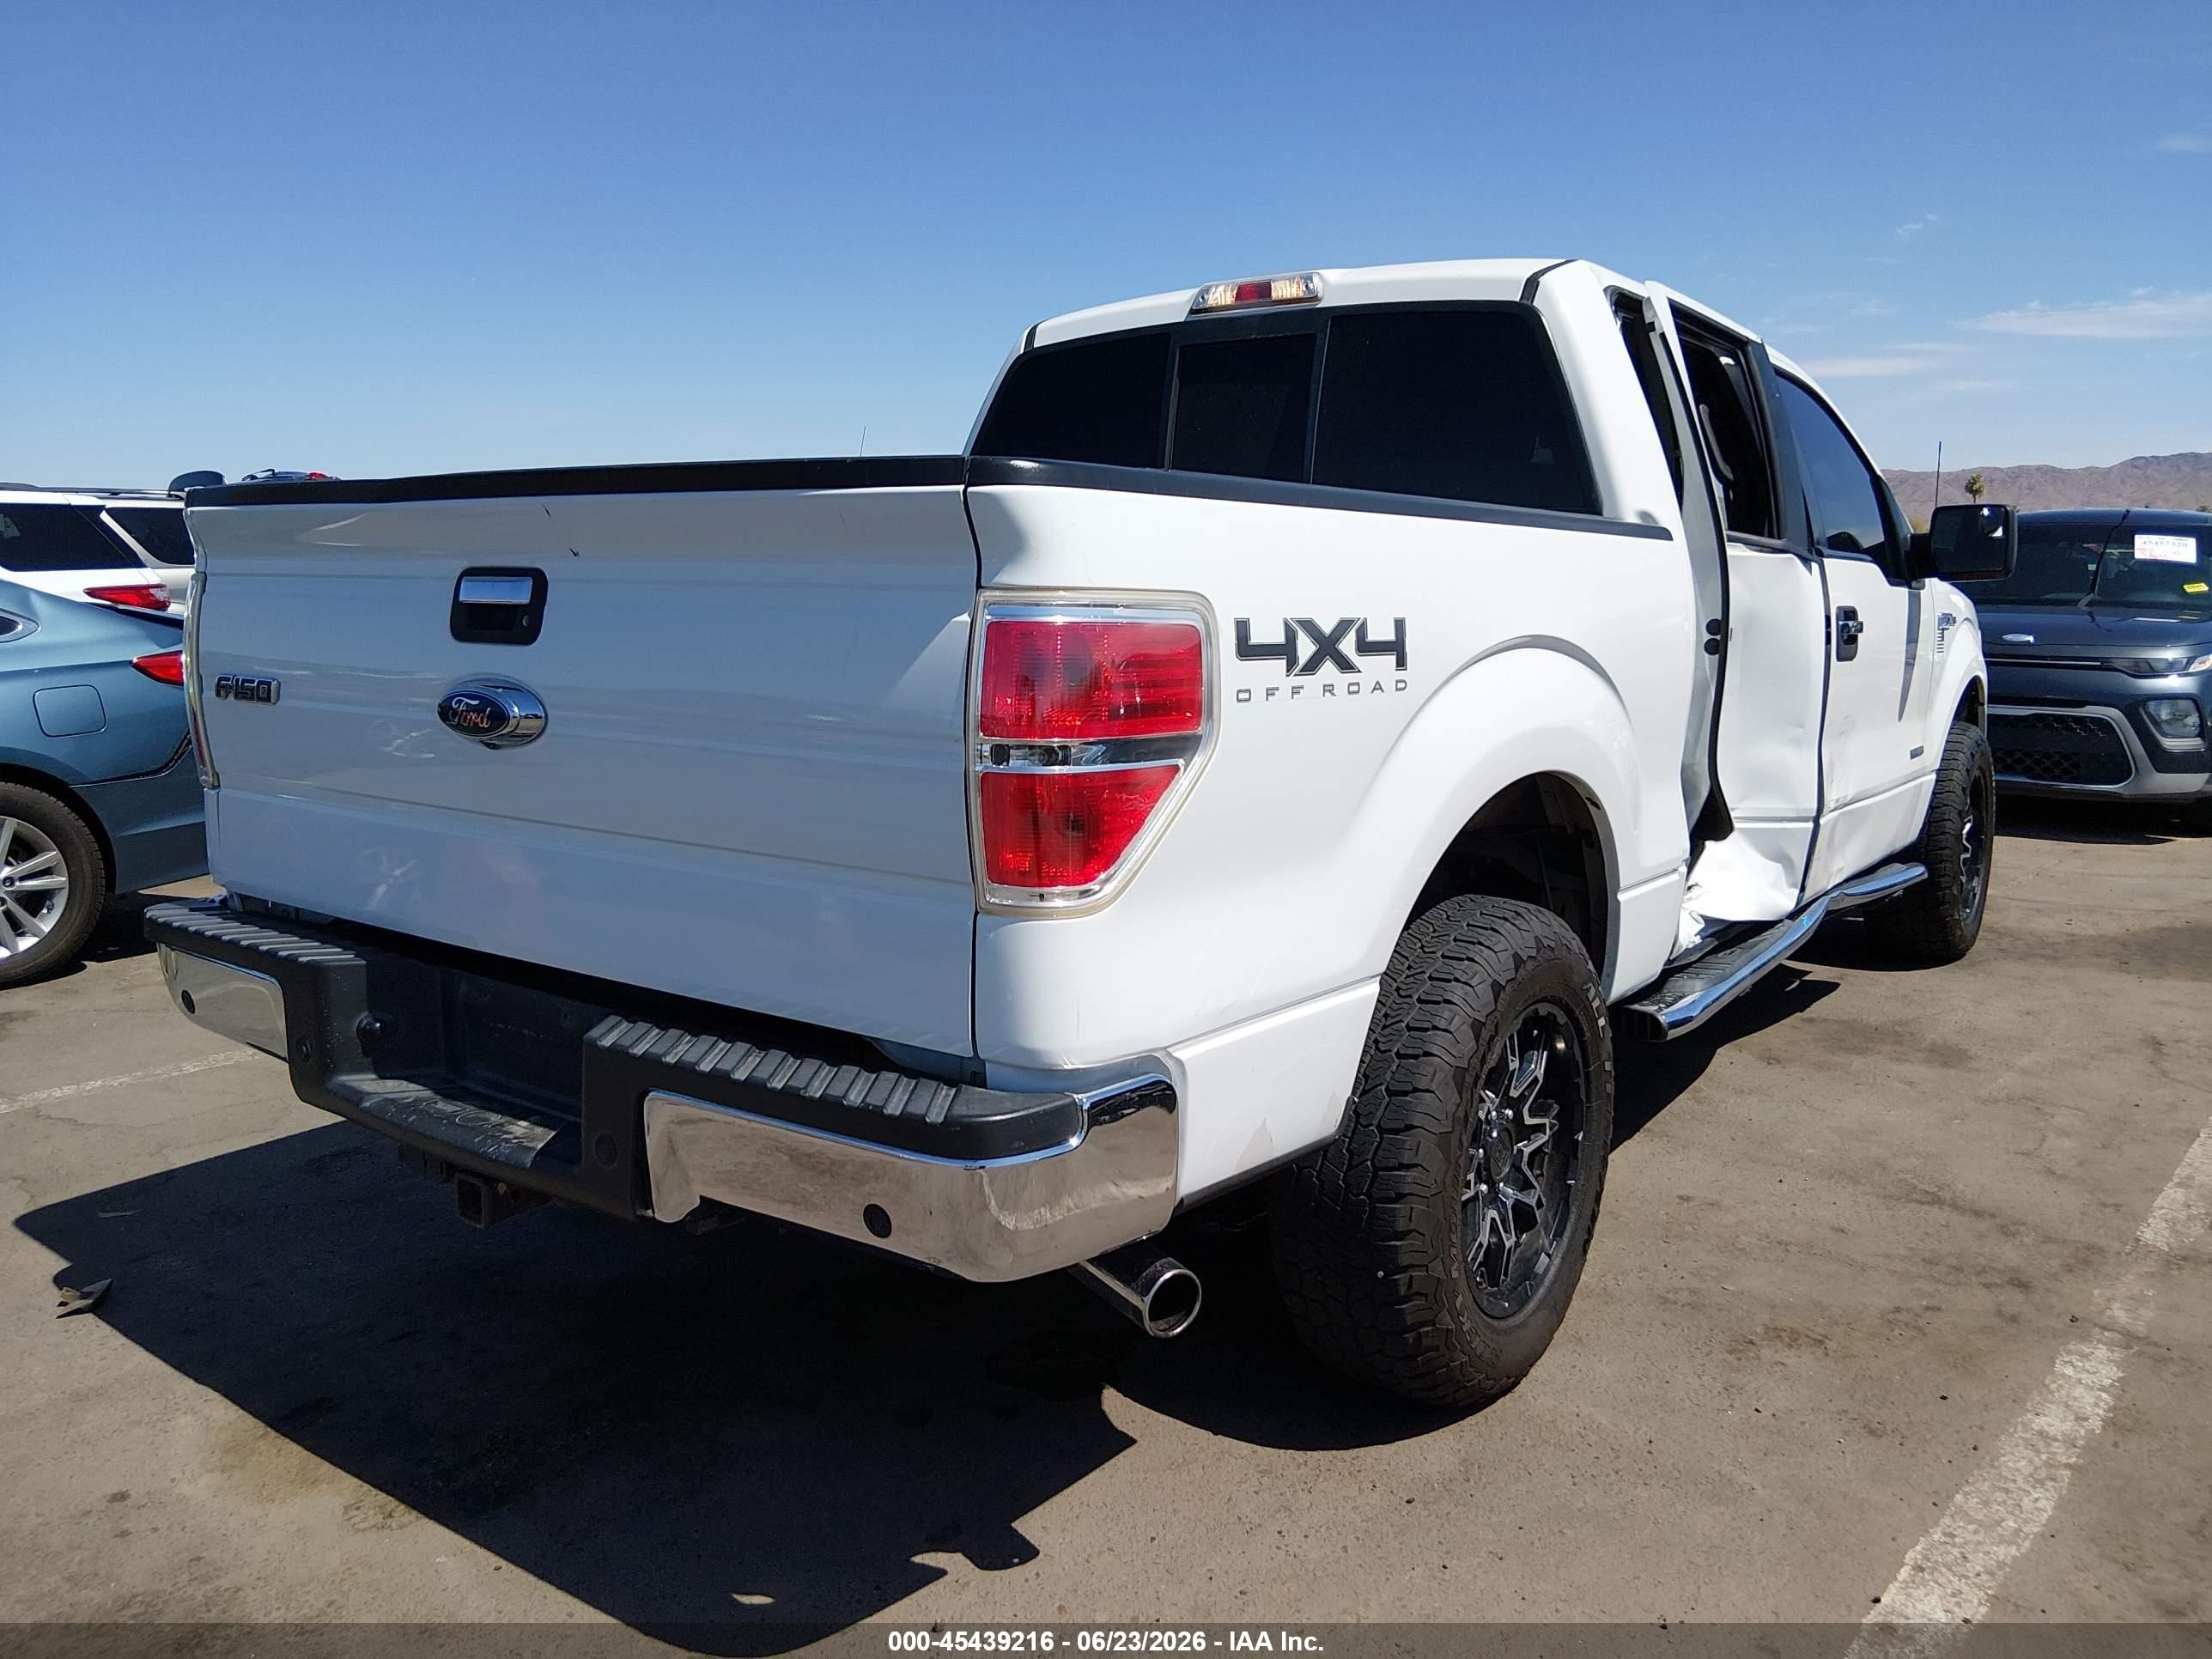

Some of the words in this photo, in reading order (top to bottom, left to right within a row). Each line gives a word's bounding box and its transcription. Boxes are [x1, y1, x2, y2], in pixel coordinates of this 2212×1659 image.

[1234, 617, 1407, 677] 4X4
[1237, 685, 1304, 702] OFF
[1322, 679, 1407, 697] ROAD
[447, 696, 492, 728] Ford
